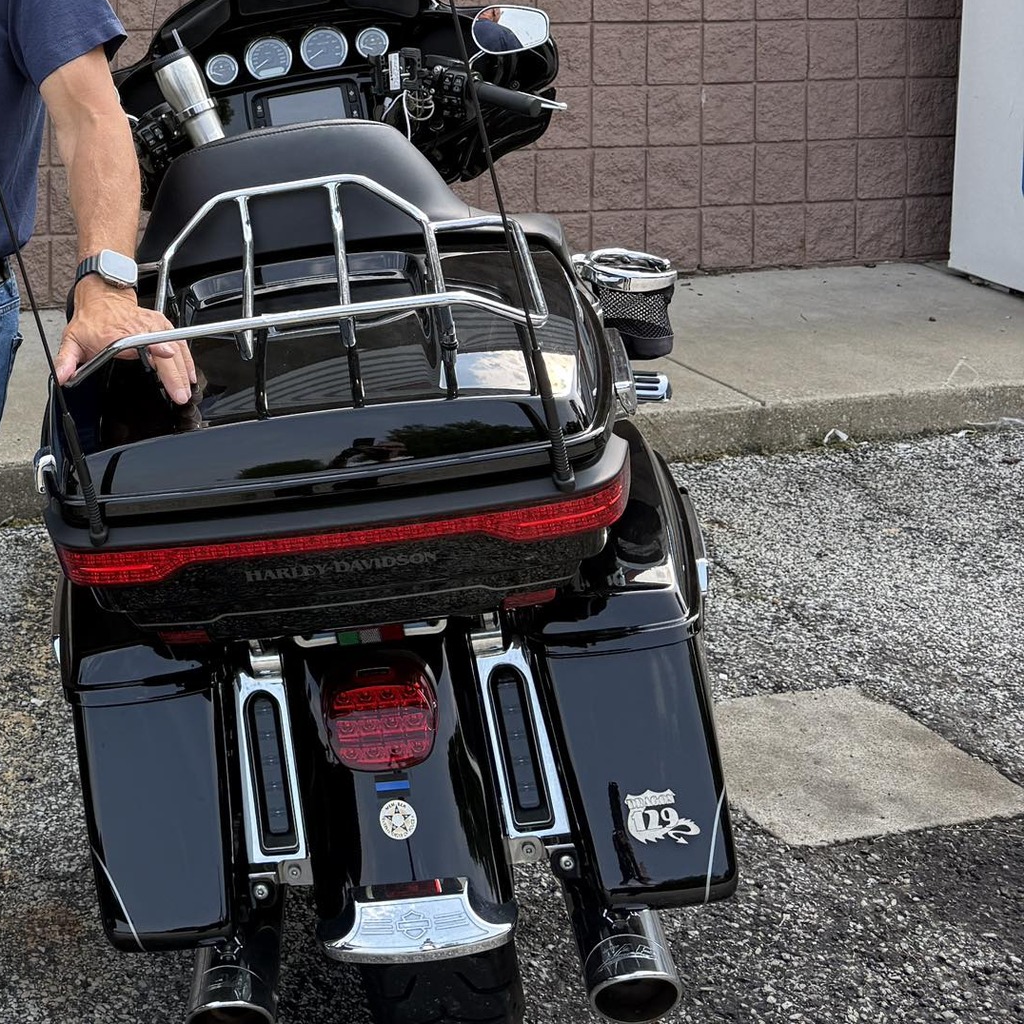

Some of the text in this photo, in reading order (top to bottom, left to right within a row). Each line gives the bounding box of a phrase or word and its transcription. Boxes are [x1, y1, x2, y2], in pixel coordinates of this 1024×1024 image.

[245, 551, 437, 582] HARLEY-DAVIDSON
[626, 794, 675, 809] DRAGON
[631, 807, 679, 833] 129
